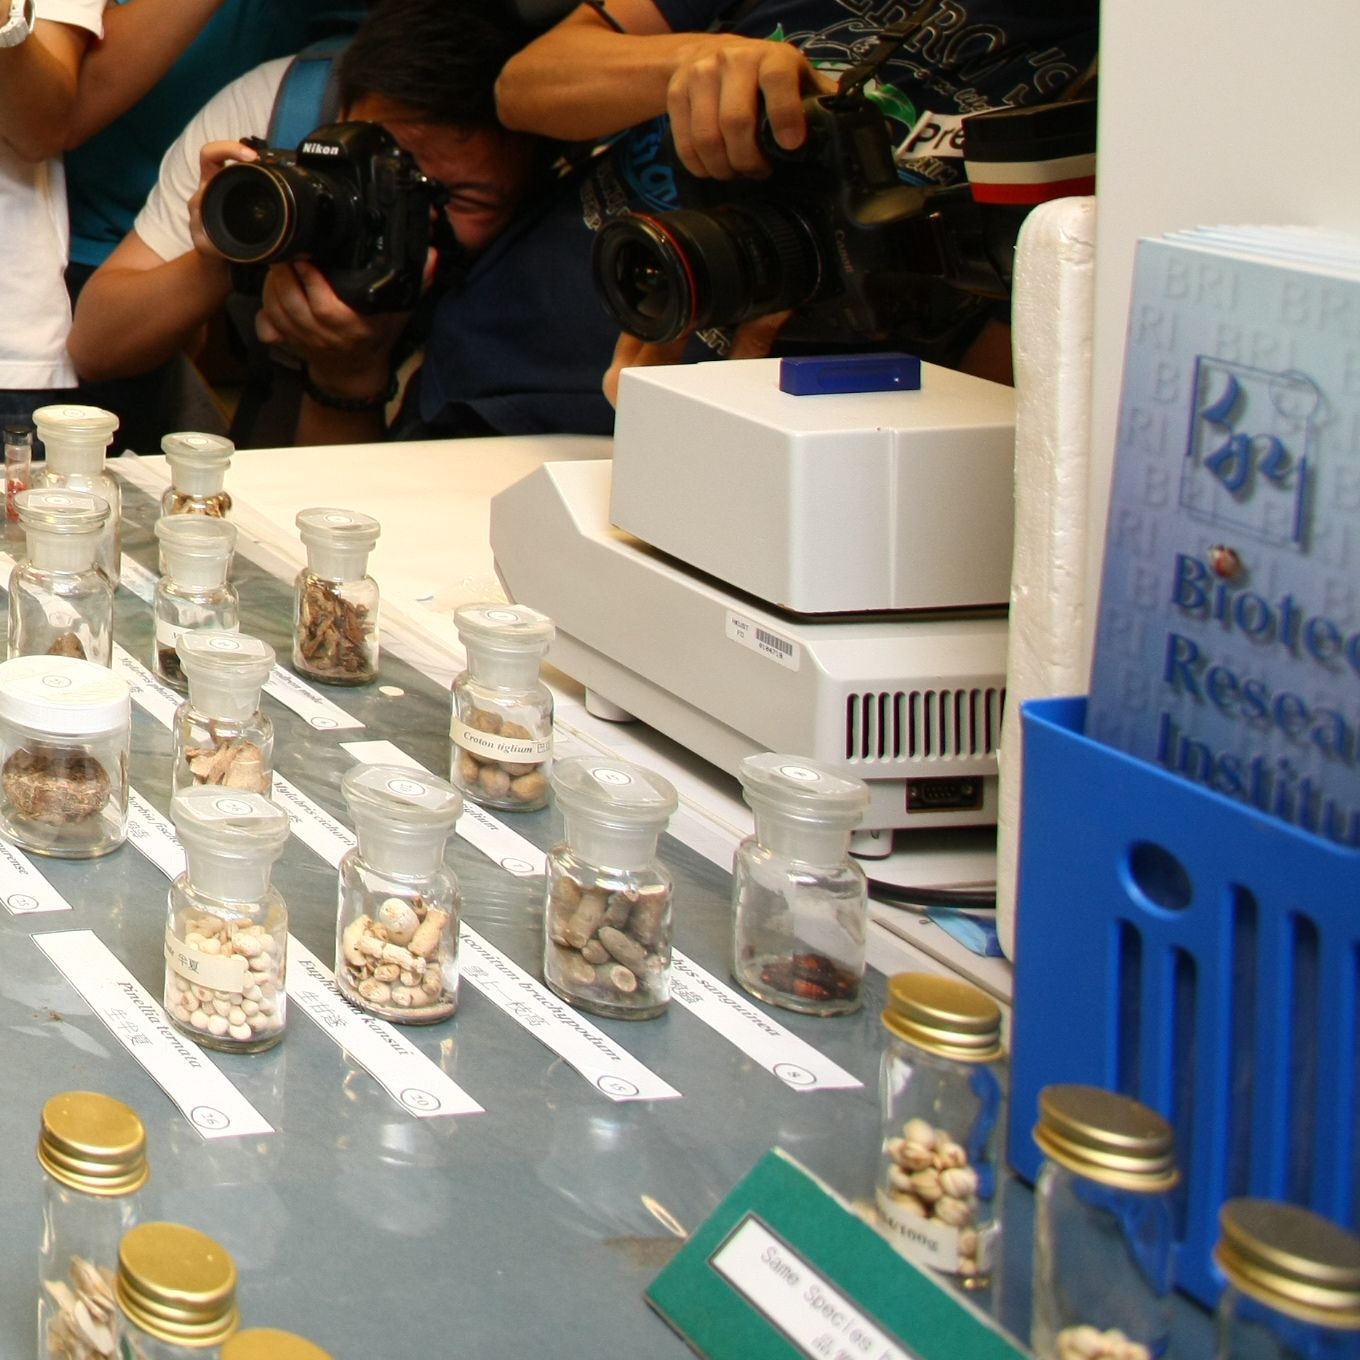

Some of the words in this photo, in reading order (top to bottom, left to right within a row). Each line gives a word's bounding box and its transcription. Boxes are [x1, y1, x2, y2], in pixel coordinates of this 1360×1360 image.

[302, 142, 339, 156] Nikon
[1163, 631, 1360, 758] Resea
[463, 730, 494, 748] Croton
[497, 742, 533, 755] tiglium
[273, 781, 317, 816] Mylabris
[117, 980, 160, 1024] Pinellia
[156, 1022, 202, 1069] ternata
[518, 981, 622, 1062] brachypodum
[696, 975, 780, 1037] sanguinea
[103, 1007, 153, 1048] 生半夏
[361, 1015, 415, 1057] kansui
[411, 1093, 430, 1107] 20
[761, 1245, 801, 1288] Same
[803, 1282, 873, 1352] Species
